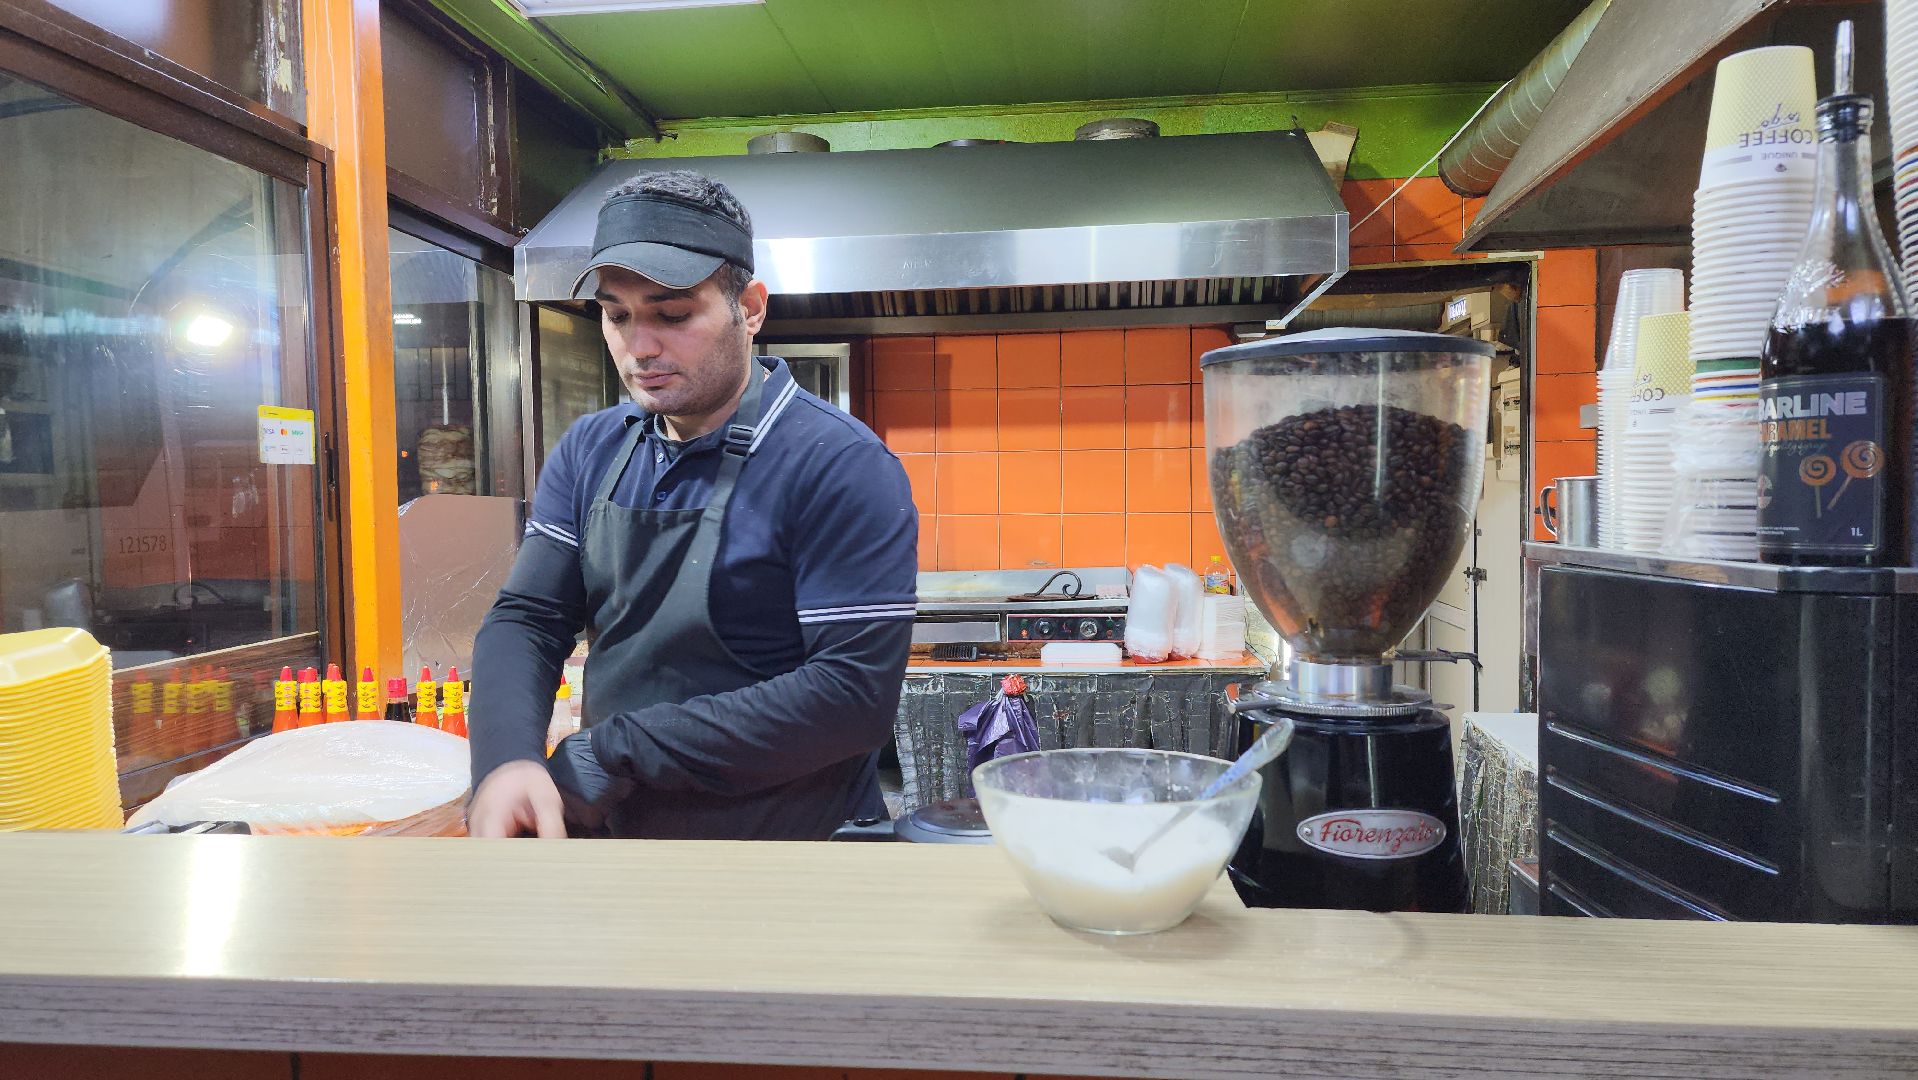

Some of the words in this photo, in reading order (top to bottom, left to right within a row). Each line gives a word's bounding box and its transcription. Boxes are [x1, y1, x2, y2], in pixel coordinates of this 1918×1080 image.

[1739, 129, 1813, 149] COFFEE
[1759, 418, 1832, 443] ARAMEL
[1851, 527, 1863, 537] 1L
[119, 534, 167, 554] 121578
